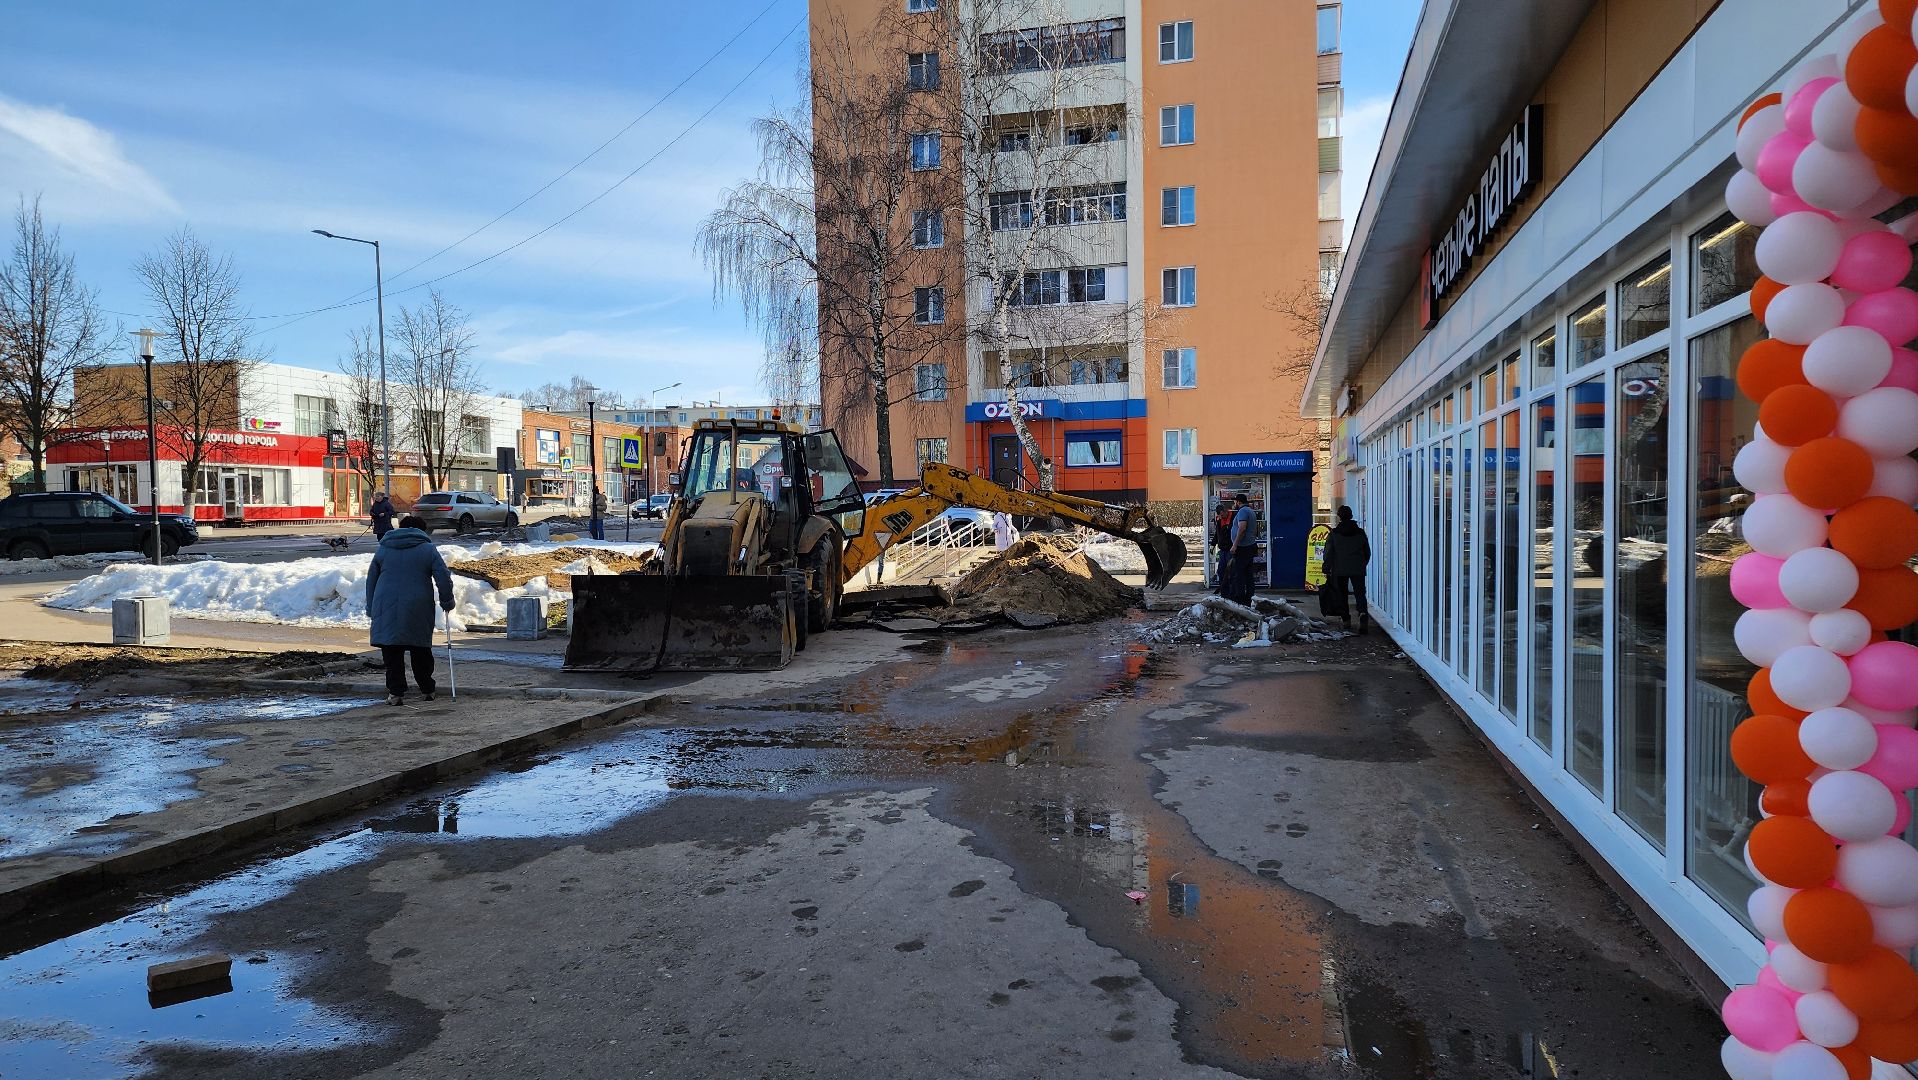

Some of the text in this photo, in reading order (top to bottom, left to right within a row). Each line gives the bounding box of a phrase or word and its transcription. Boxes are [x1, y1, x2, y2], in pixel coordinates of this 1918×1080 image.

[1478, 104, 1530, 245] лапы
[984, 402, 1042, 418] OZON
[244, 435, 279, 447] ГОРОДА
[1211, 457, 1305, 469] МОСКОВСКИЙ МК КОМСОМОЛЕЦ
[886, 510, 913, 535] JCB
